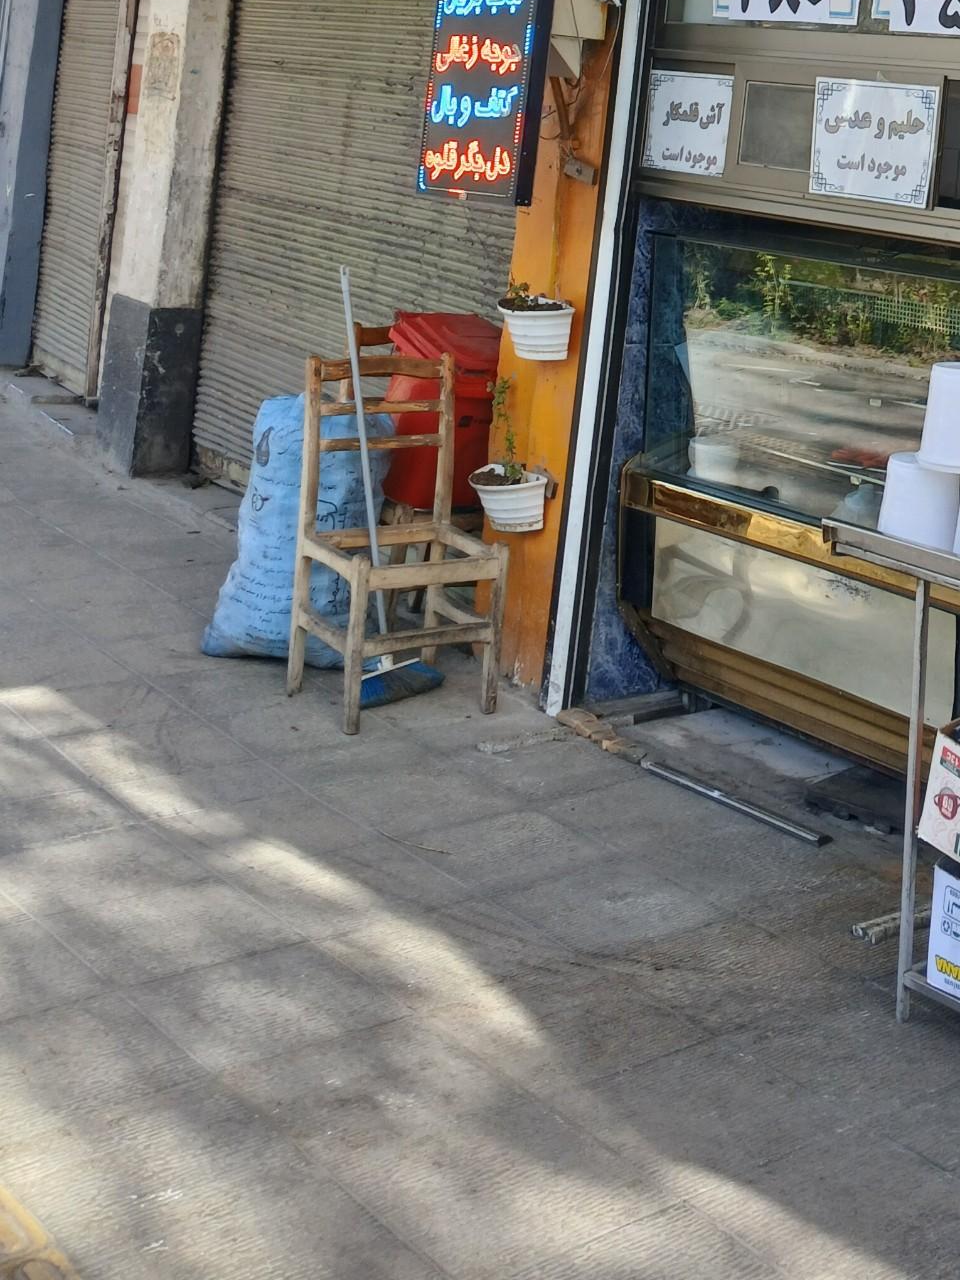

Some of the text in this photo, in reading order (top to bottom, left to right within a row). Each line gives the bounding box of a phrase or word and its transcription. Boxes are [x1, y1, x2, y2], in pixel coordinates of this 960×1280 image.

[435, 35, 523, 75] جوجه زغالی
[430, 84, 520, 128] کتف و بال
[662, 101, 725, 130] آش قلمکار
[824, 109, 926, 140] حلیم و عدس
[424, 140, 511, 181] دل جگر قلوه
[661, 145, 718, 171] موجود است
[836, 152, 907, 182] موجود است
